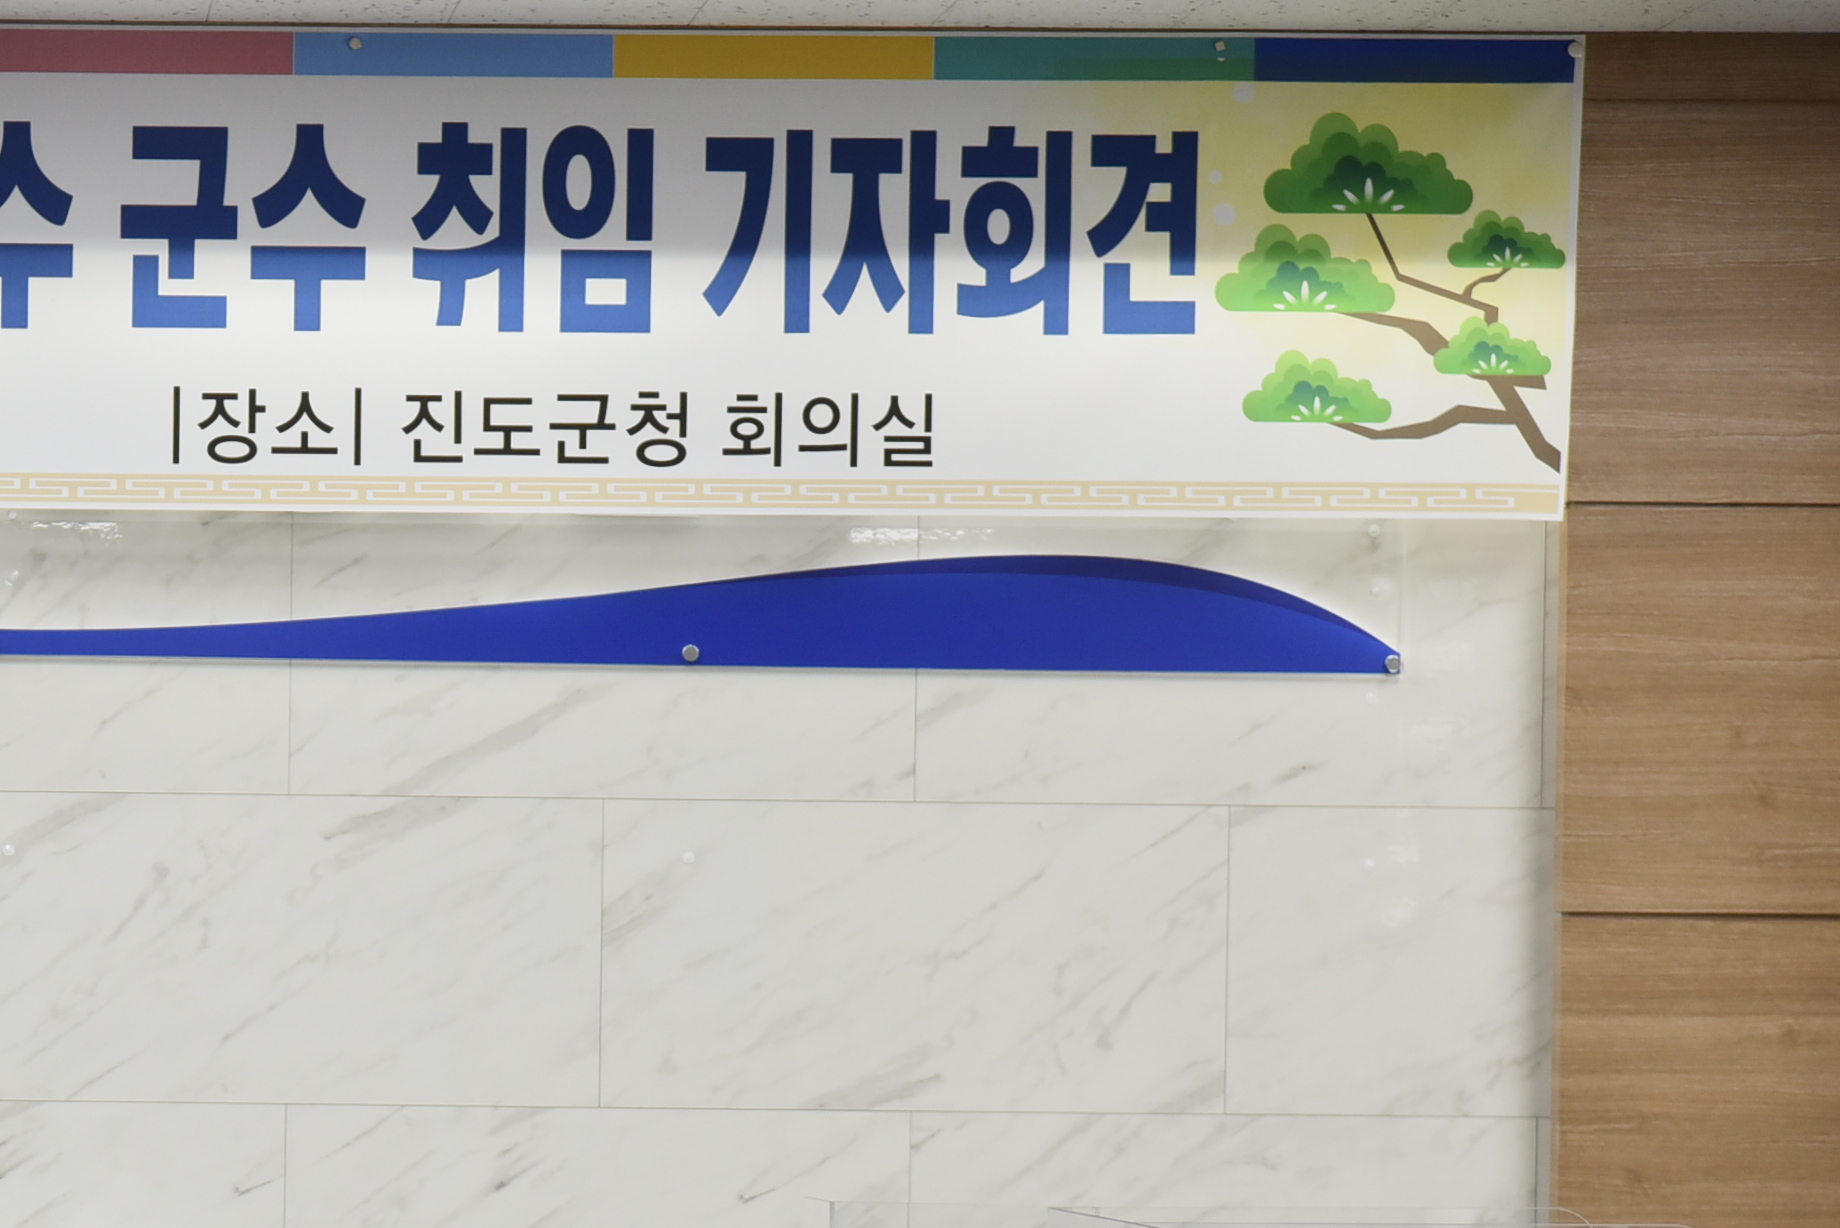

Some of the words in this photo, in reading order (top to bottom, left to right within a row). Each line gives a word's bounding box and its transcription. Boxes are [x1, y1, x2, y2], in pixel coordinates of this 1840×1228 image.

[120, 124, 366, 331] 군수
[412, 122, 654, 333] 취임
[703, 126, 1199, 335] 기자회견
[403, 391, 687, 467] 진도군청
[722, 392, 933, 467] 회의실
